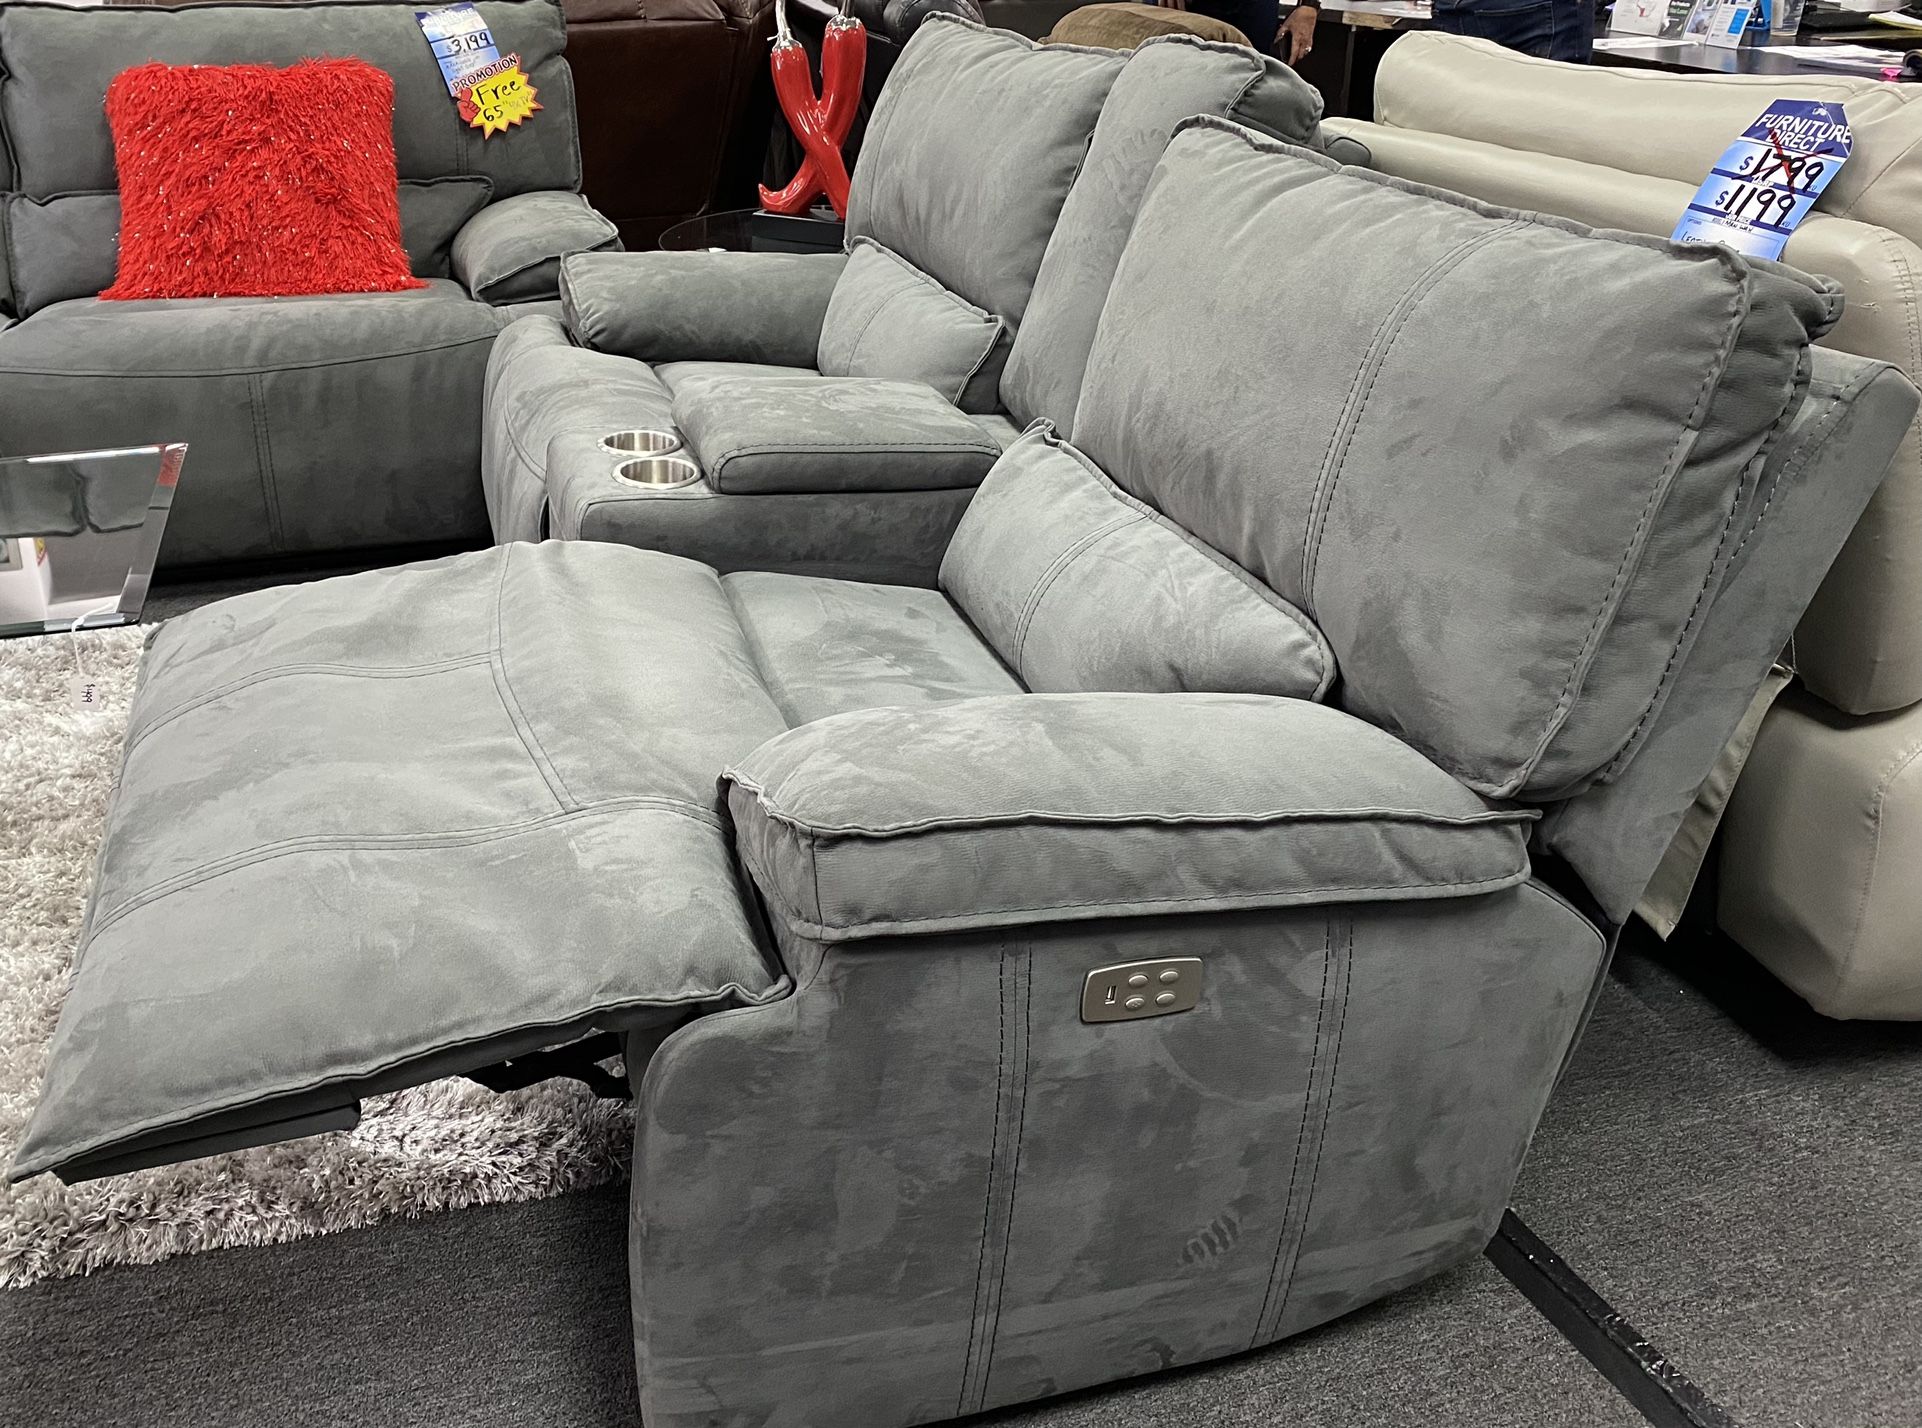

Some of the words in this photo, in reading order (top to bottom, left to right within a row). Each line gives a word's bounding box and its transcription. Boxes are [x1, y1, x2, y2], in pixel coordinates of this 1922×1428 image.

[452, 55, 518, 91] PROMOTION
[476, 80, 521, 105] Free
[1755, 113, 1852, 144] FURNITURE
[1766, 129, 1825, 151] DIRECT
